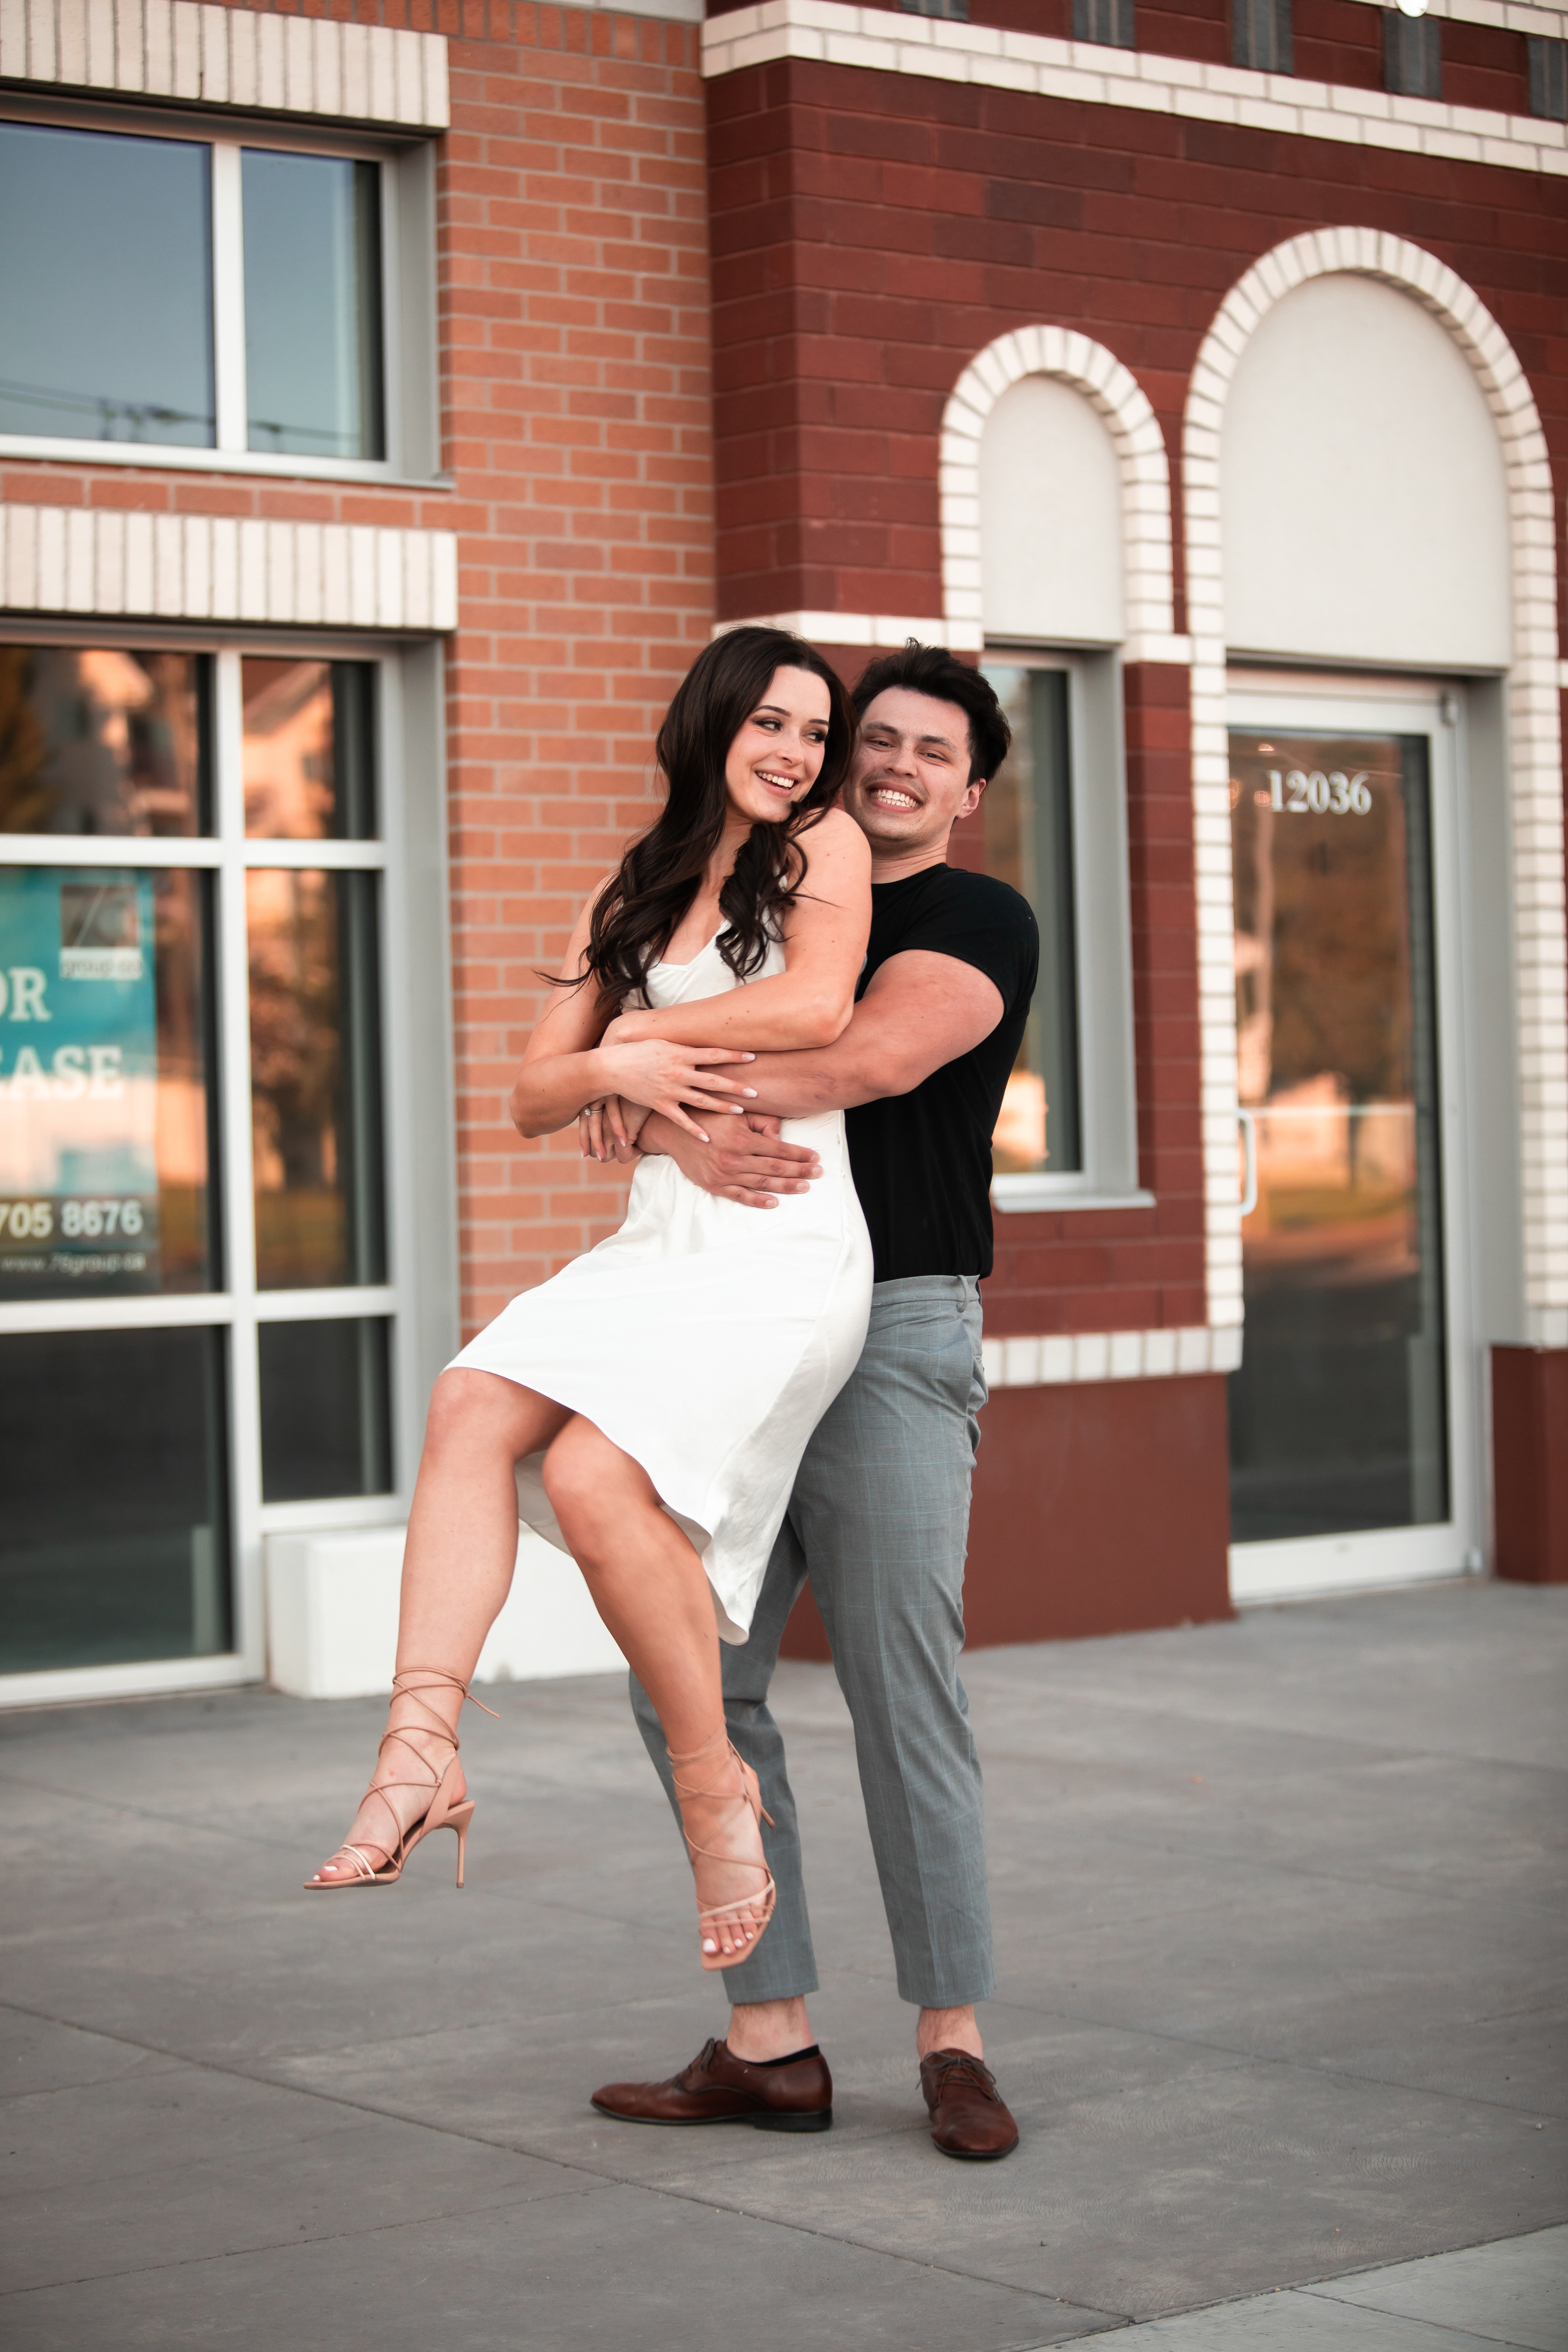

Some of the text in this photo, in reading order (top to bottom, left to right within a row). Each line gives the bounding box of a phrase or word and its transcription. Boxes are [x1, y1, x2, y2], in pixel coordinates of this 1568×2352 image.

[1268, 770, 1372, 815] 12036
[0, 966, 53, 1021] R
[0, 1045, 122, 1098] ASE
[60, 1200, 143, 1238] 8676
